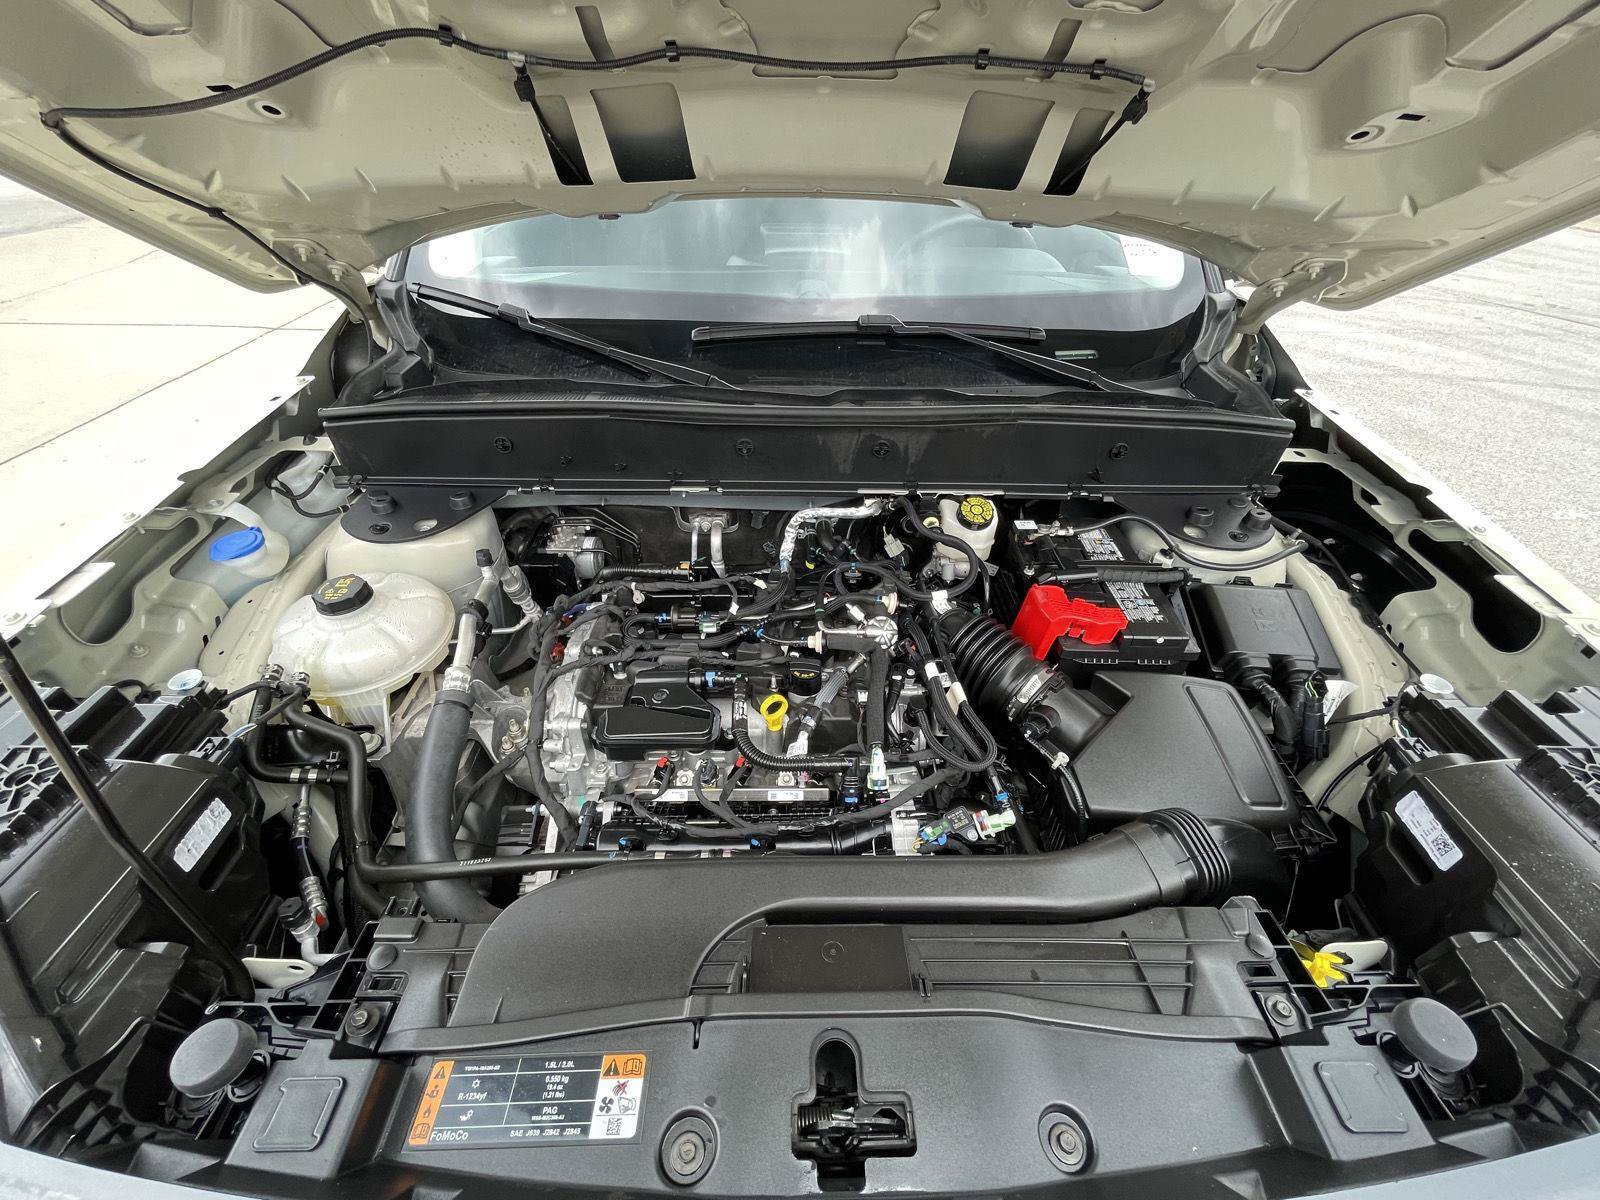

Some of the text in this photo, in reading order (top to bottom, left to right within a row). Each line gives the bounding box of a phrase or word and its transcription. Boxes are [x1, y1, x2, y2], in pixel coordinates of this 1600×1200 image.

[561, 1075, 569, 1084] kg
[457, 1091, 487, 1101] R-1234yf
[542, 1106, 558, 1114] PAG
[429, 1130, 469, 1141] FoMoCo
[509, 1129, 524, 1137] SAE
